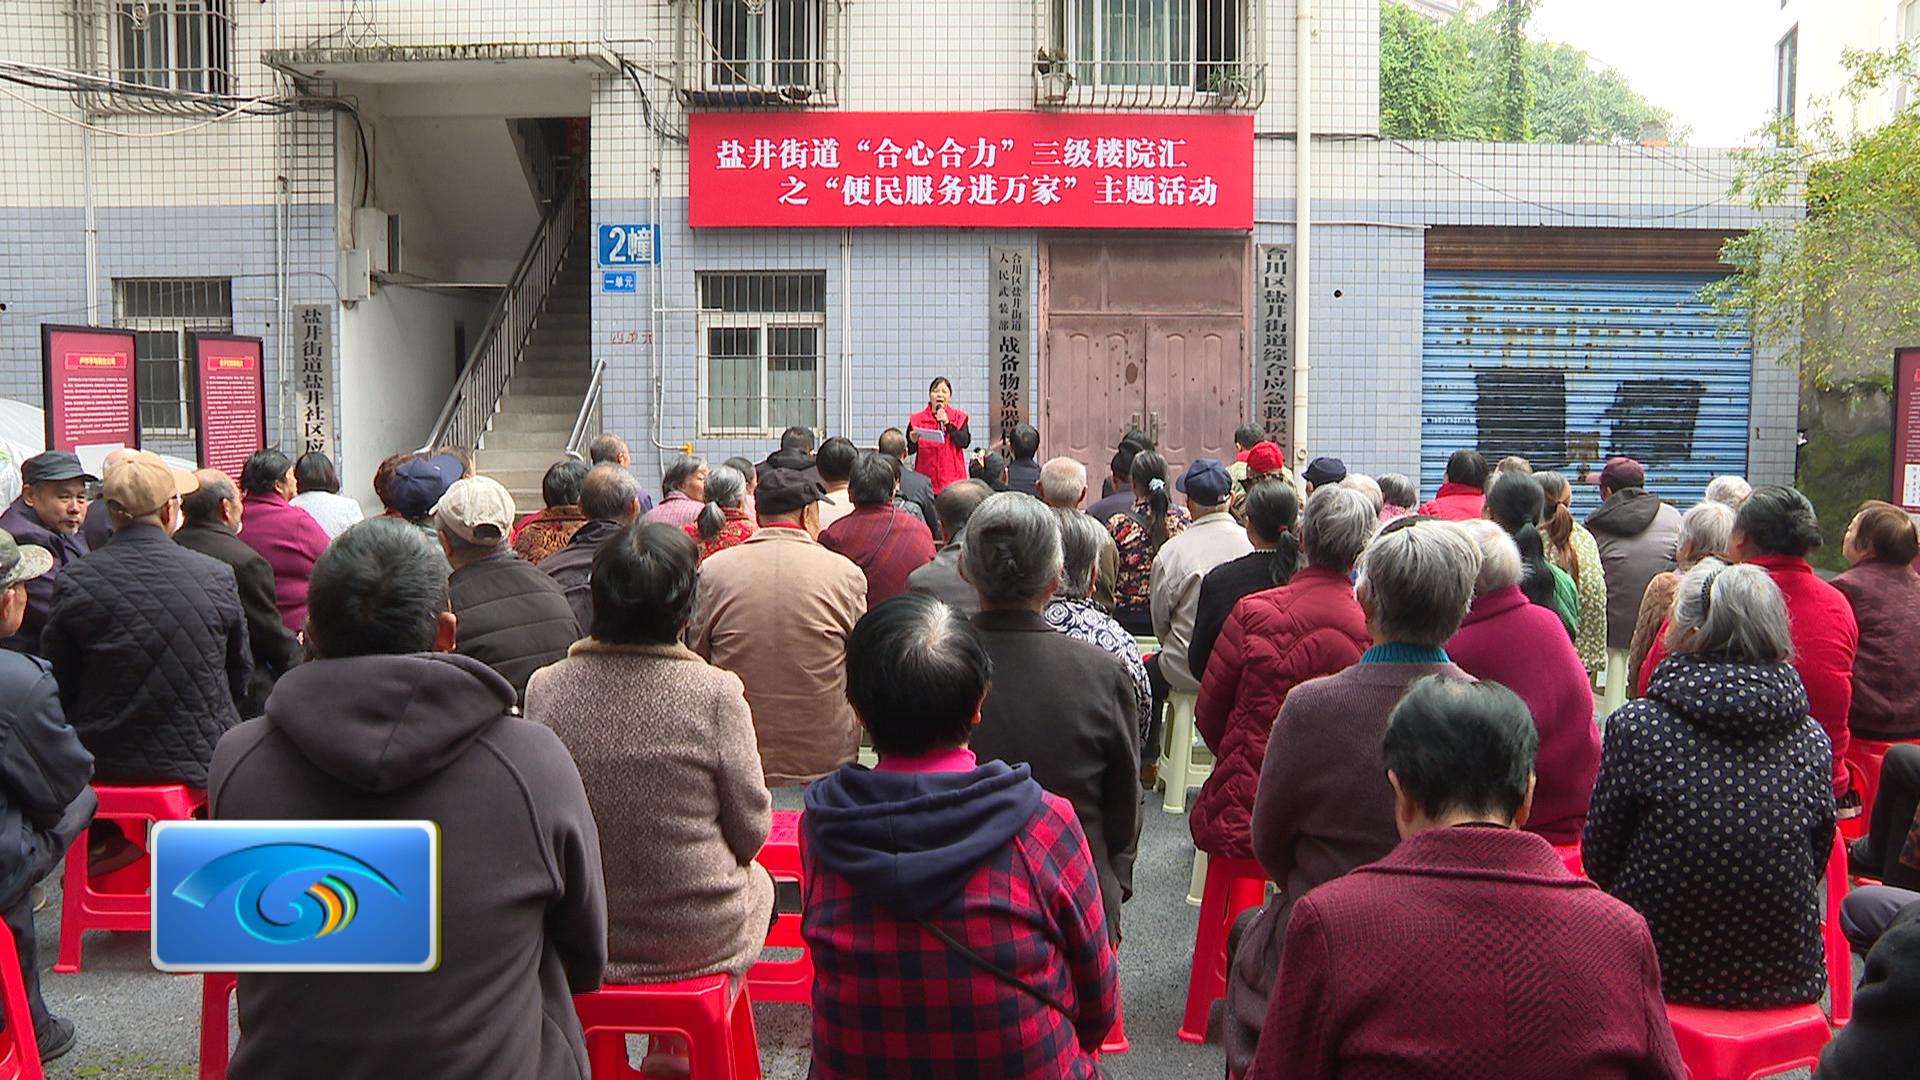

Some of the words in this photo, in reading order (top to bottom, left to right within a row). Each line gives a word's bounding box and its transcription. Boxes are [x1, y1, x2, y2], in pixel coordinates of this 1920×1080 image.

[716, 138, 1187, 169] 盐井街道“合心合力”三级楼院汇
[778, 175, 1218, 206] 之“便民服务进万家”主题活动
[605, 275, 634, 289] 一单元
[998, 252, 1009, 332] 人民武装部
[302, 308, 325, 455] 盐井街道盐井社区应
